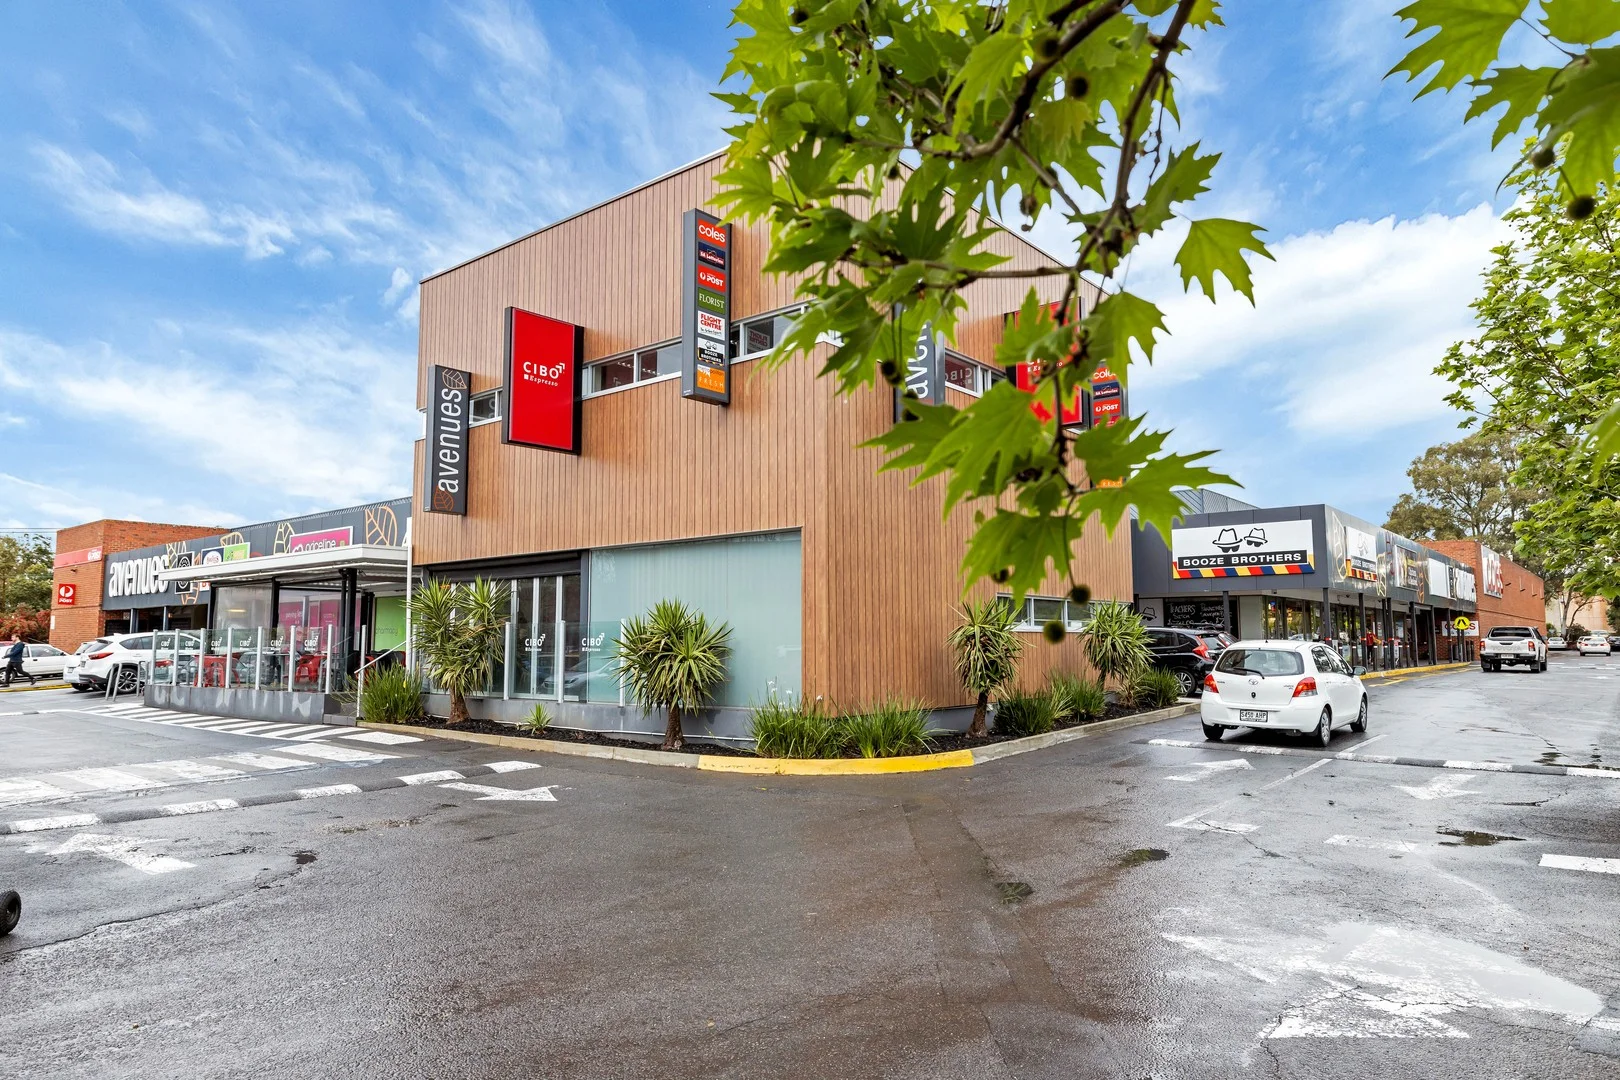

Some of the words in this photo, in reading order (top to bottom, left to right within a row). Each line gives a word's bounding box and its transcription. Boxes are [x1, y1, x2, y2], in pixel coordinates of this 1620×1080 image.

[698, 224, 726, 242] coles
[706, 276, 724, 286] POST
[699, 292, 724, 309] FLORIST
[700, 314, 722, 324] FLIGHT
[700, 320, 721, 330] CENTRE
[523, 361, 560, 379] CIBO
[530, 376, 558, 387] Espresso
[699, 376, 724, 388] FRESH
[438, 388, 462, 493] avenues
[1183, 557, 1224, 567] BOOZE
[1232, 553, 1302, 564] BROTHERS
[108, 554, 169, 598] avenues
[525, 638, 543, 646] CIBO
[581, 638, 601, 646] CIBO
